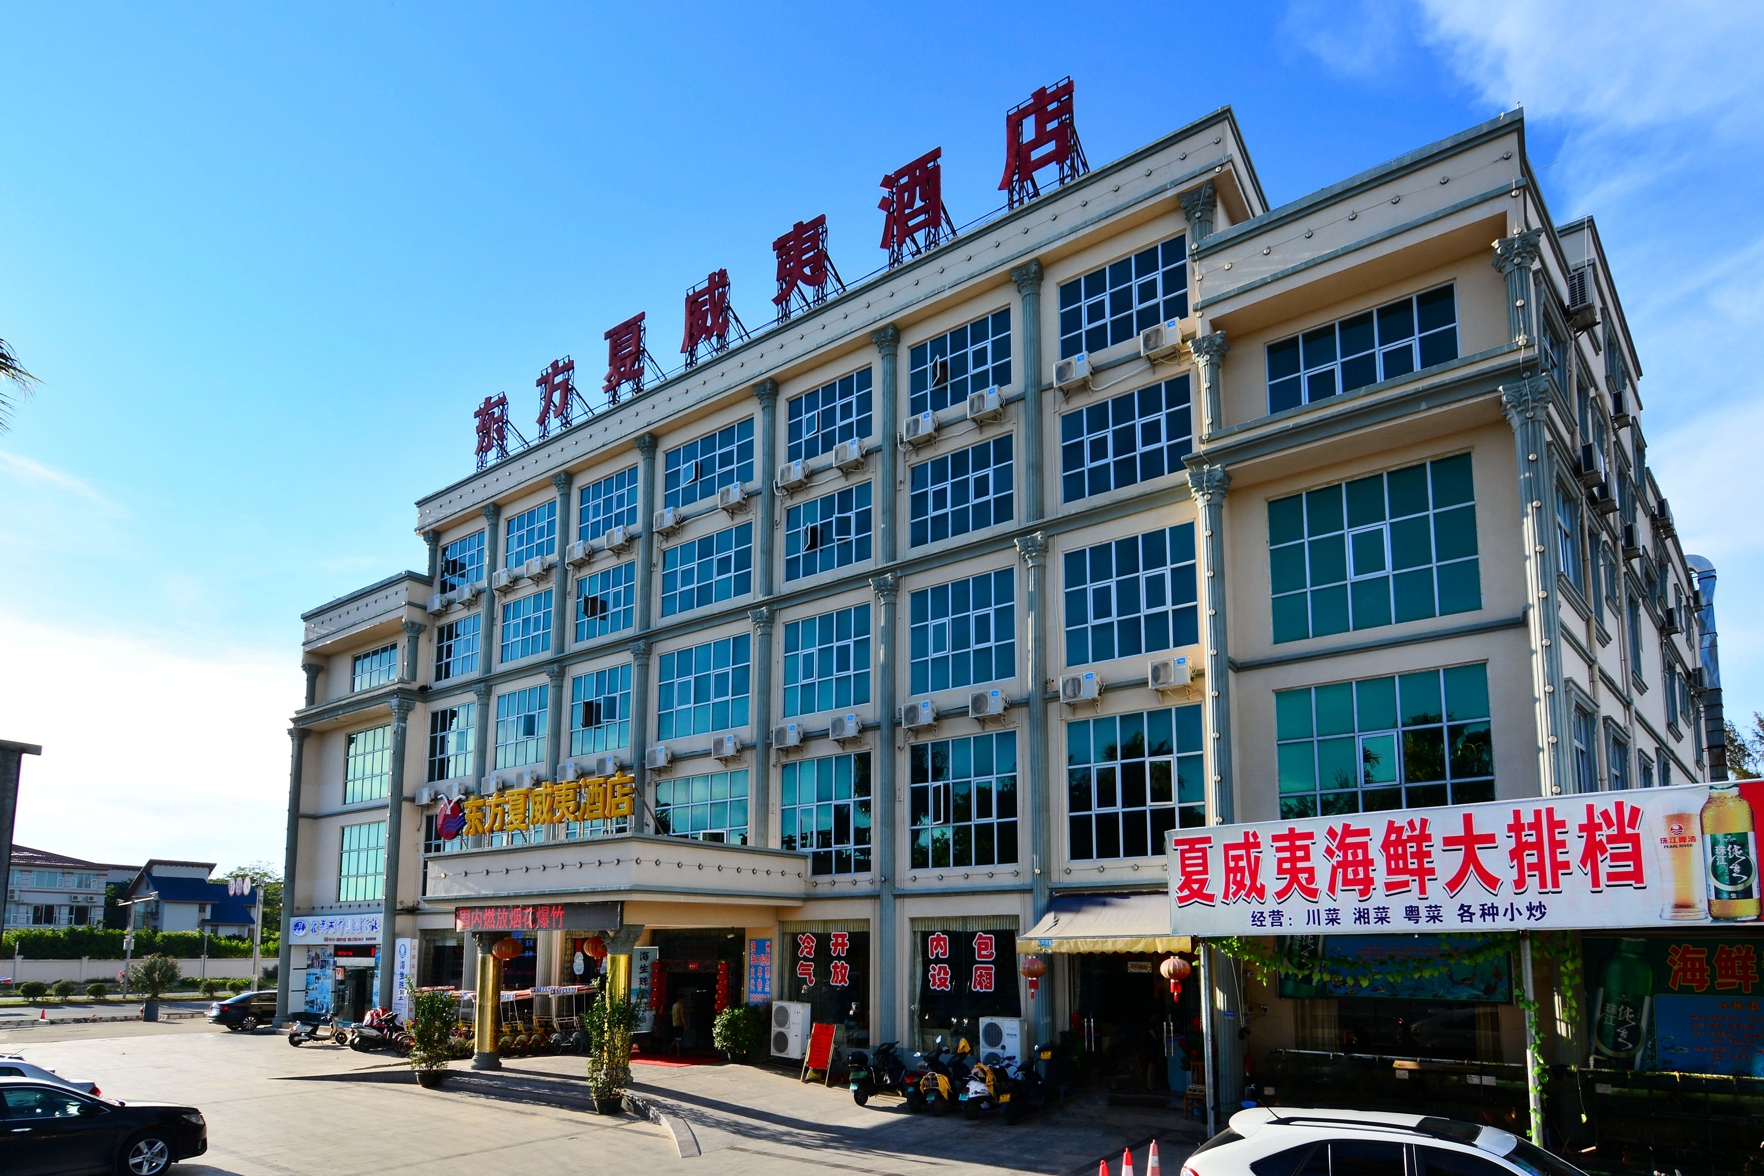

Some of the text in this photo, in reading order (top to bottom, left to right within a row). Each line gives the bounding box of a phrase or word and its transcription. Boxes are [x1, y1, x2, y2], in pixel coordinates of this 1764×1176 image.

[474, 78, 1075, 457] 东方夏威夷酒店
[464, 771, 634, 836] 东方夏威夷酒店
[1660, 836, 1696, 844] 珠江啤酒
[1172, 800, 1647, 908] 夏威夷海鲜大排档
[1715, 846, 1727, 865] 珠江
[456, 906, 564, 929] 围内燃放烟花爆竹
[1306, 908, 1342, 927] 川菜
[1353, 907, 1391, 926] 湘菜
[1403, 905, 1444, 925] 粤菜
[1457, 902, 1547, 924] 各种小炒
